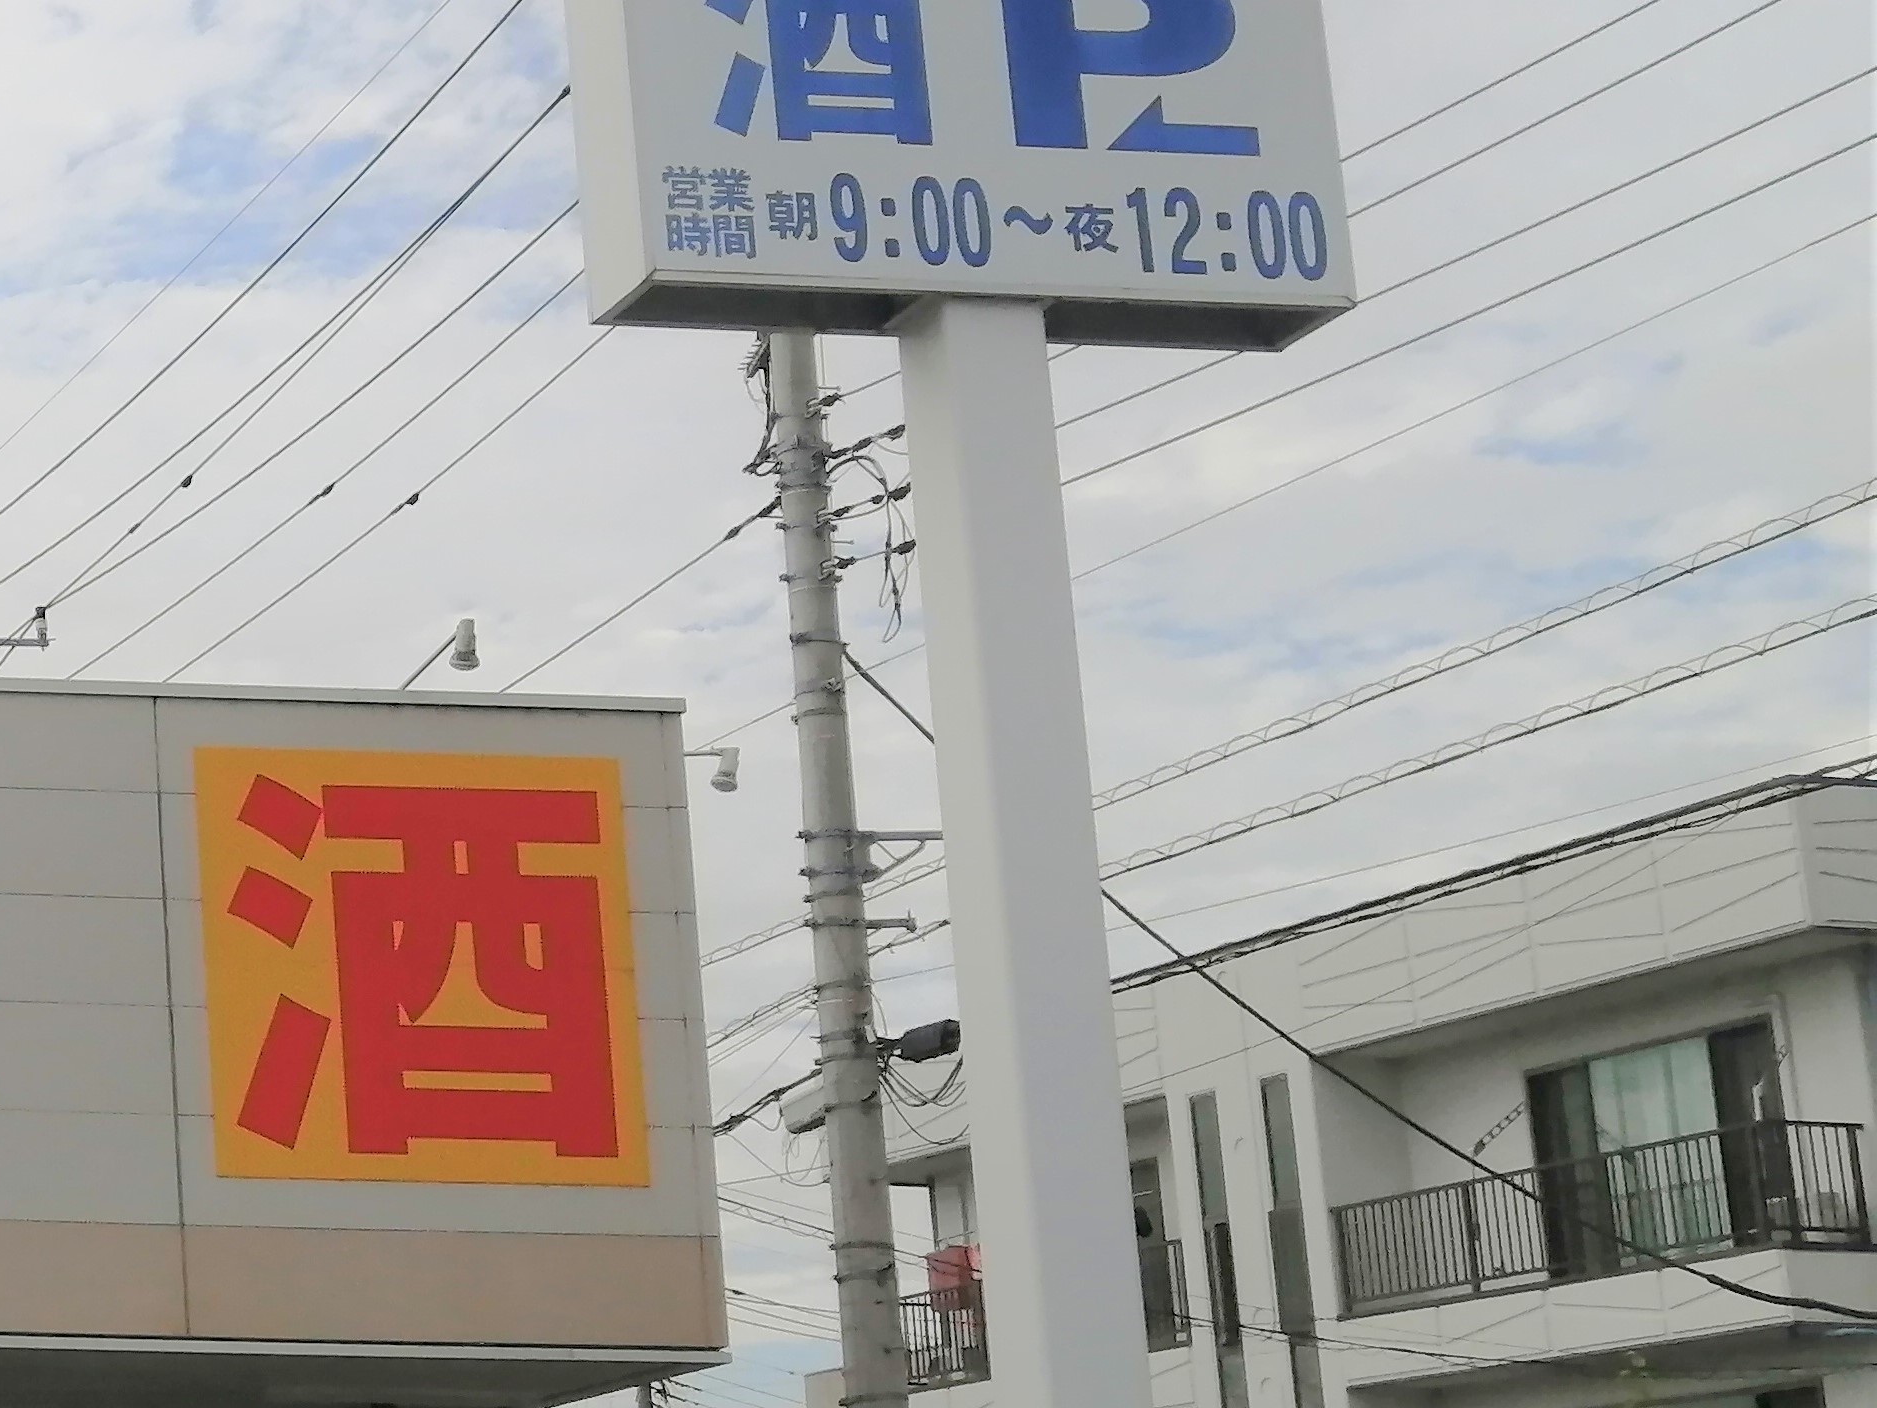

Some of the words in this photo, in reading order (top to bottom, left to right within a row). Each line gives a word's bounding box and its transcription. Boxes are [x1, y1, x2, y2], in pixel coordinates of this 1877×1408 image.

[661, 164, 753, 213] 営業
[665, 212, 757, 259] 時間
[226, 773, 620, 1160] 酒
